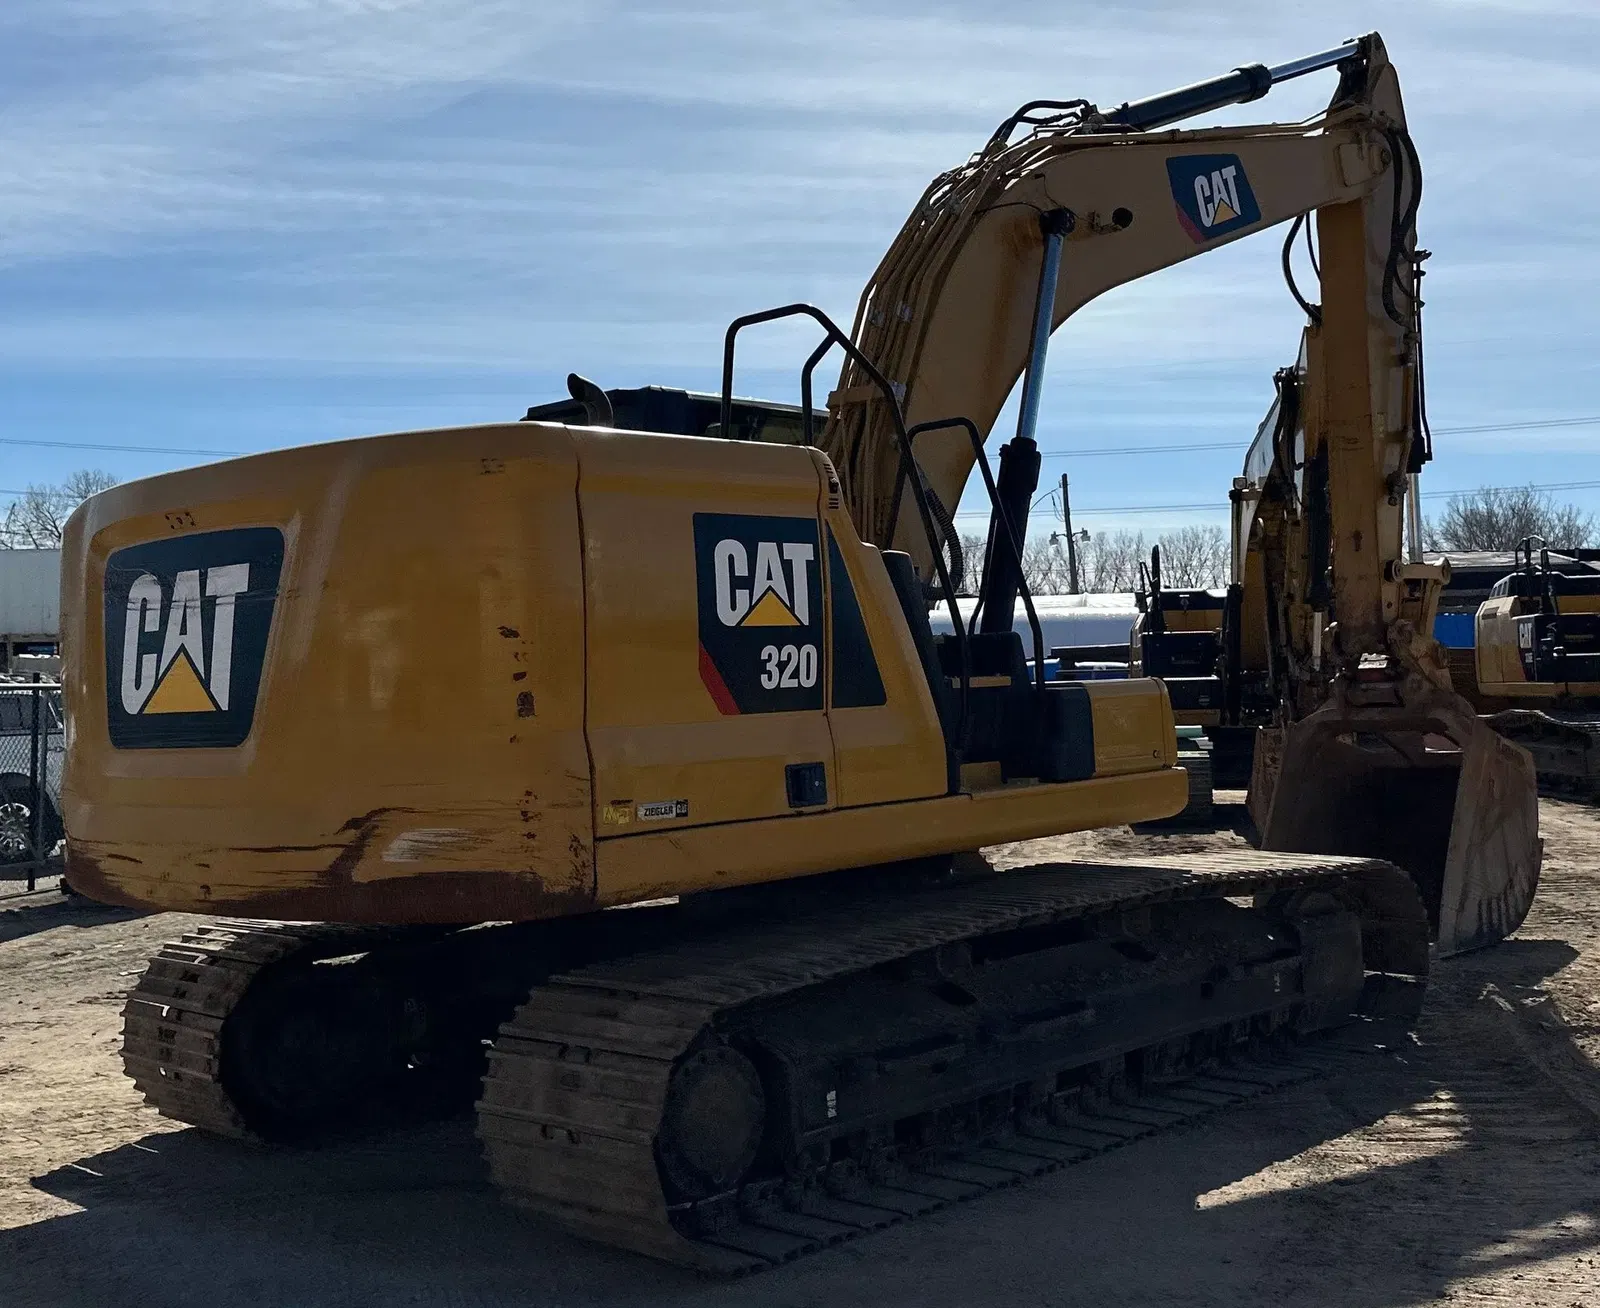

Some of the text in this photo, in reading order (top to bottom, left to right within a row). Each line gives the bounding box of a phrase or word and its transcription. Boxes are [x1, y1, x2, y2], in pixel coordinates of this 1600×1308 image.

[1194, 165, 1242, 228] CAT
[714, 539, 814, 627] CAT
[121, 563, 250, 715] CAT
[1520, 623, 1532, 648] CAT
[760, 645, 818, 689] 320
[644, 806, 674, 817] ZIEGLER
